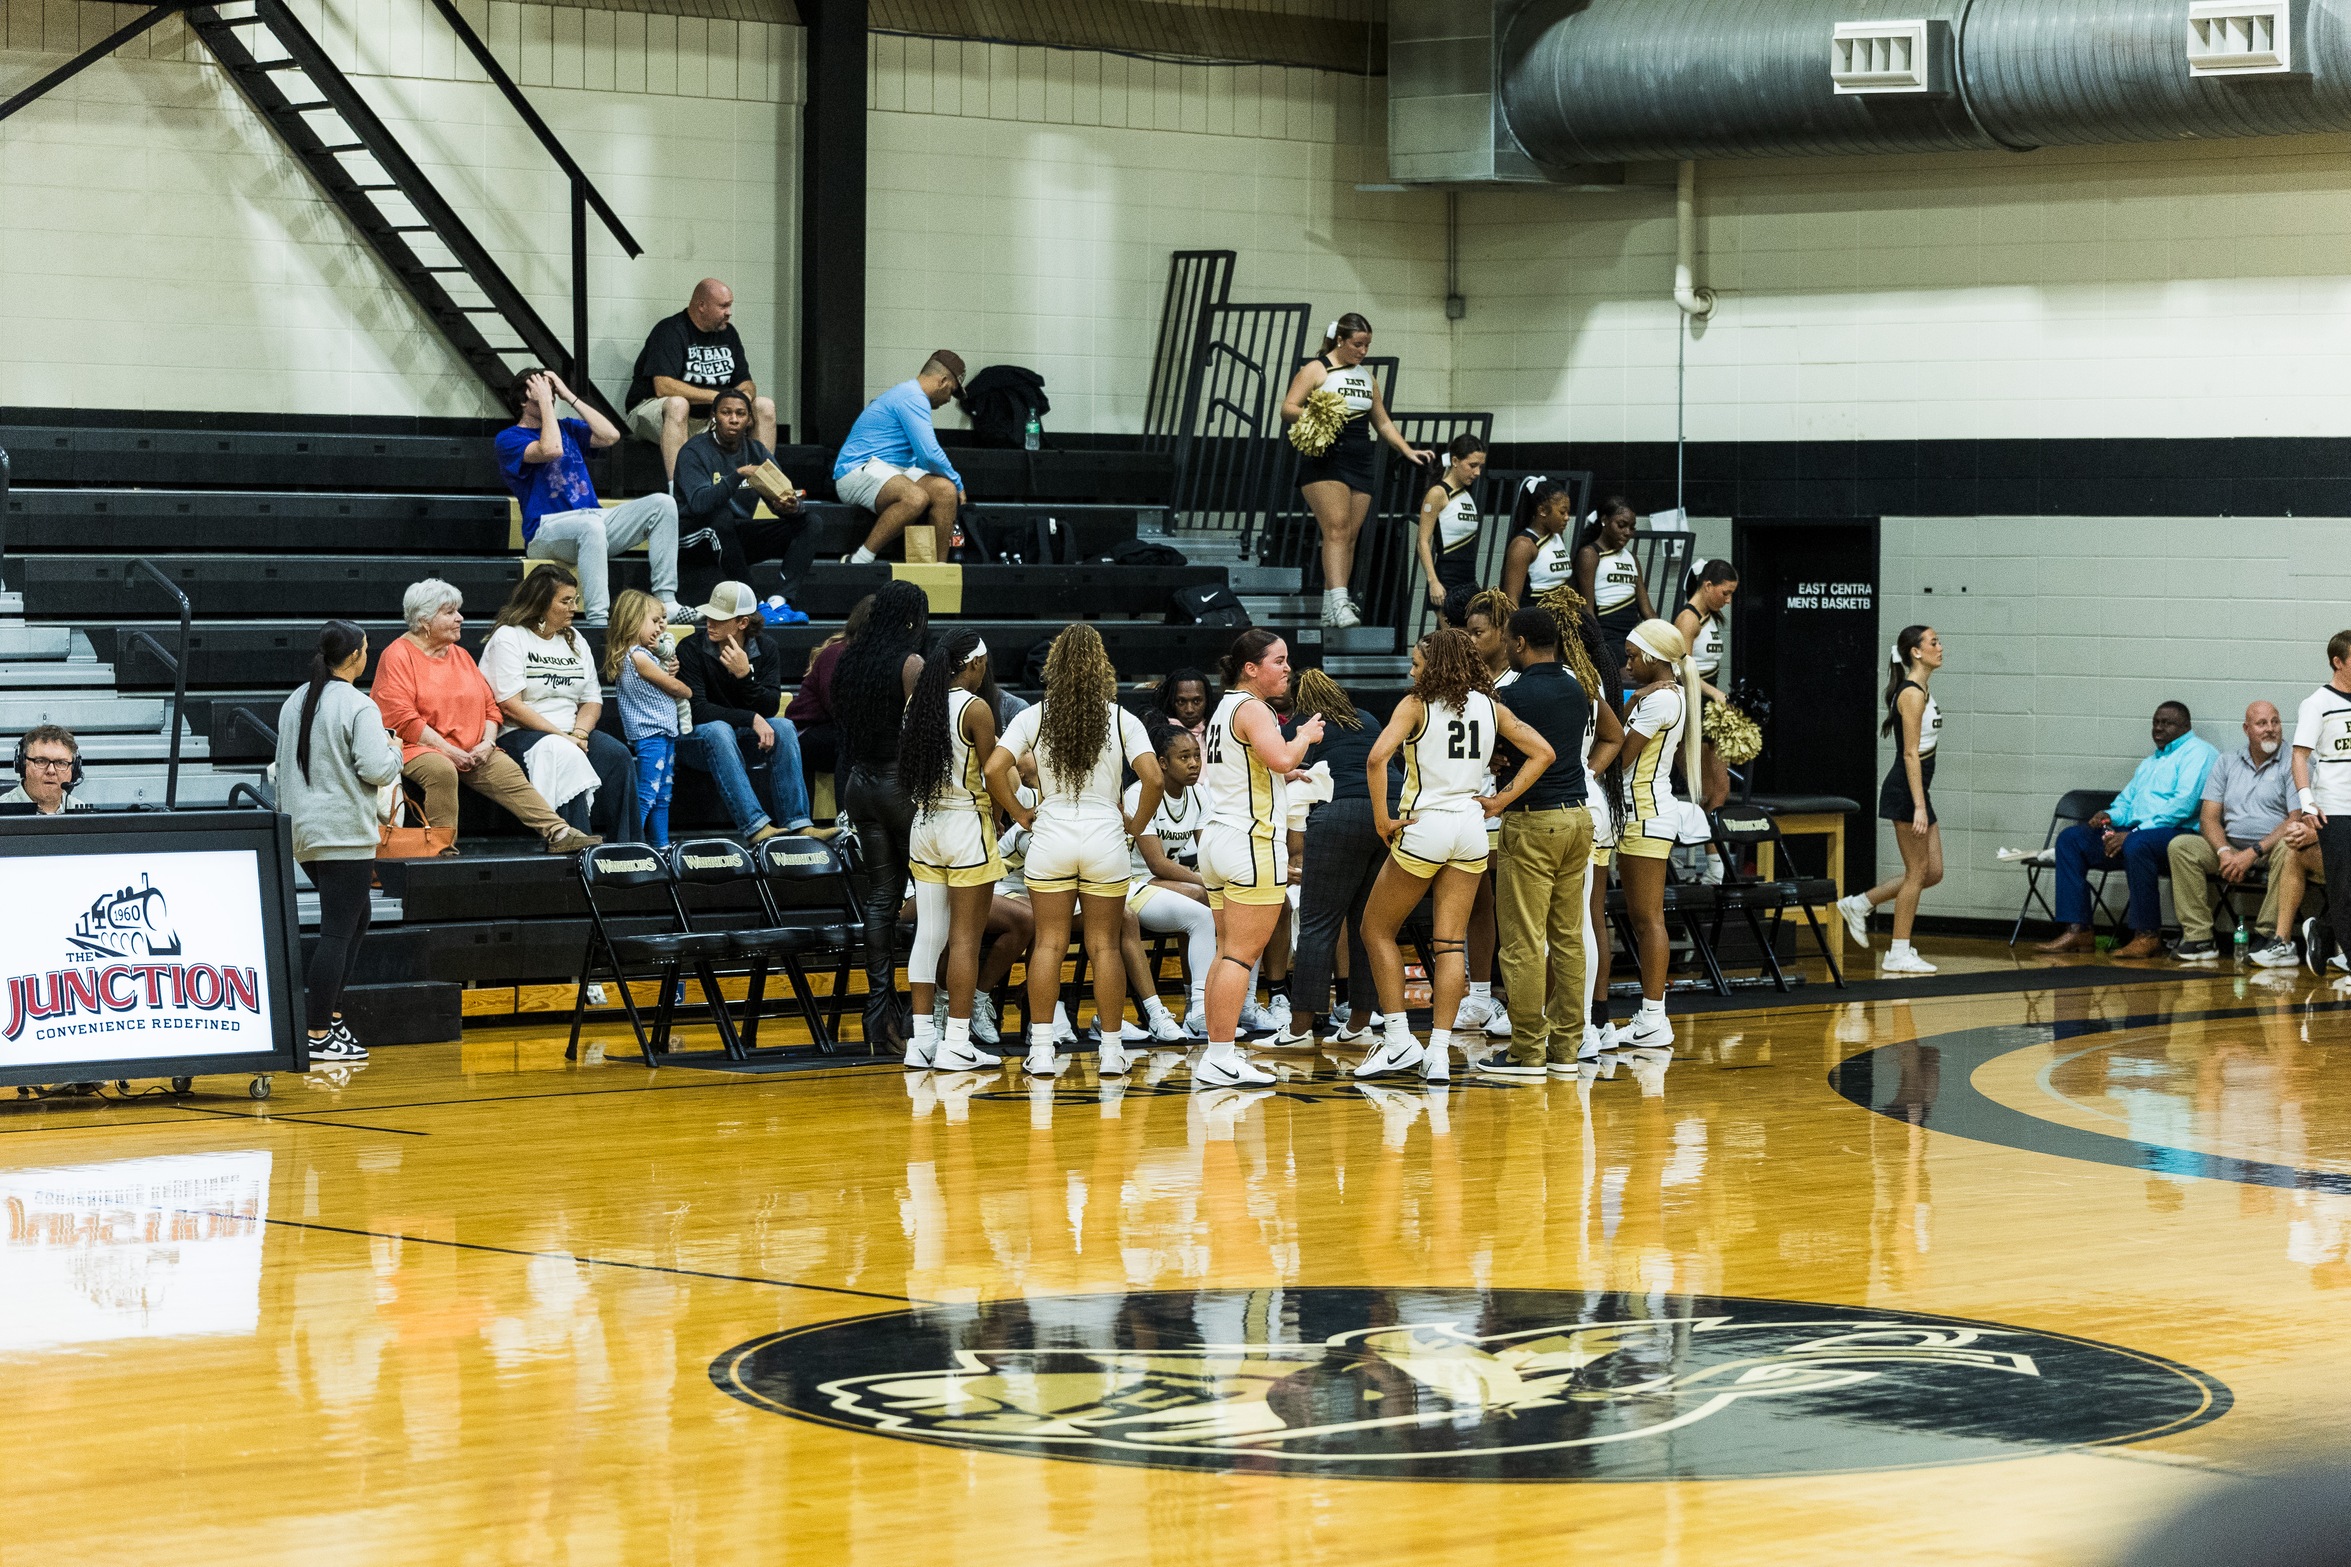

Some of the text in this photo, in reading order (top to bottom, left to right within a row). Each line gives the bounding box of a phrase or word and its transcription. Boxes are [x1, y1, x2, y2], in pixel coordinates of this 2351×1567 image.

[704, 347, 732, 361] BAD
[1345, 378, 1365, 387] EAST
[1615, 562, 1634, 571] EAST
[1798, 582, 1872, 595] EAST CENTRA
[1787, 596, 1871, 609] MEN'S BASKETB
[528, 652, 578, 666] WARRIOR
[543, 673, 572, 689] Mom
[1207, 724, 1223, 764] 22
[1448, 720, 1481, 759] 21
[594, 857, 657, 874] WARRIORS
[682, 853, 743, 869] WARRIORS
[770, 850, 830, 867] WARRIORS
[114, 904, 141, 922] 1960
[66, 951, 94, 963] THE
[2, 963, 260, 1042] JUNCTION
[36, 1017, 240, 1041] CONVENIENCE REDEFINED
